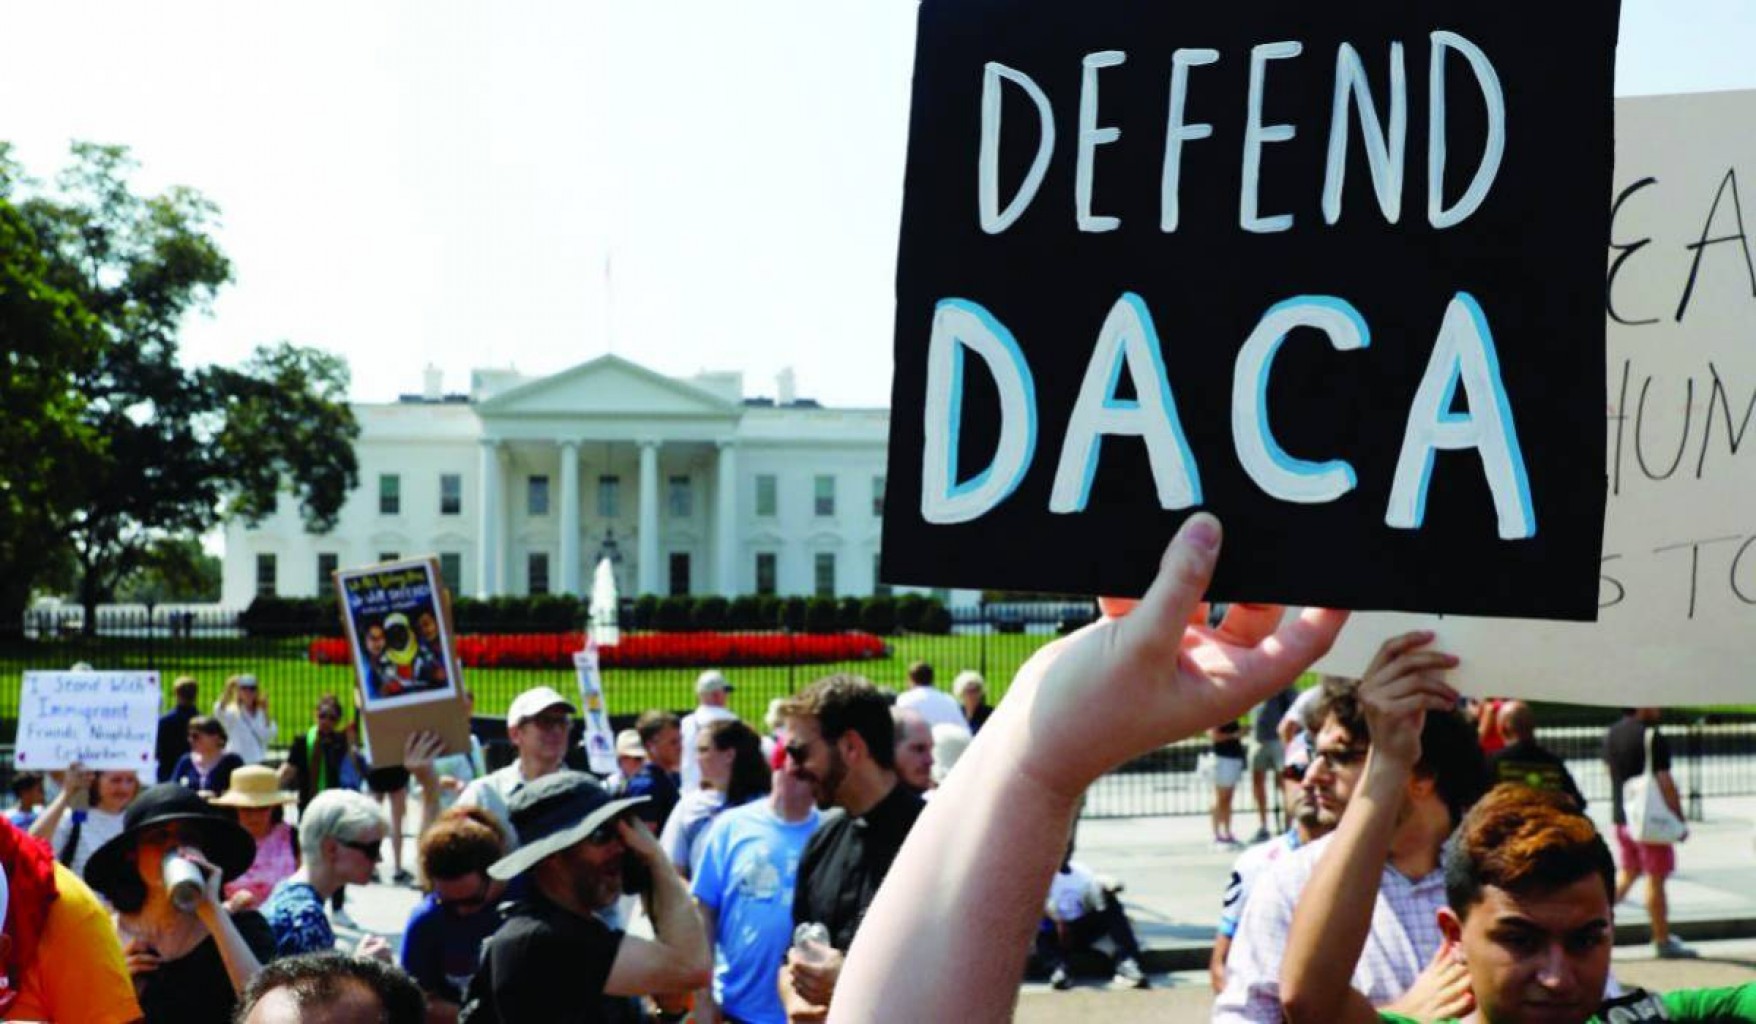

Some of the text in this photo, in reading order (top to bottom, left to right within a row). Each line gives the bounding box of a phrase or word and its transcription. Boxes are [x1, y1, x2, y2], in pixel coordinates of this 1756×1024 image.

[979, 31, 1505, 234] DEFEND
[921, 292, 1535, 540] DACA
[38, 696, 129, 723] Immigrant
